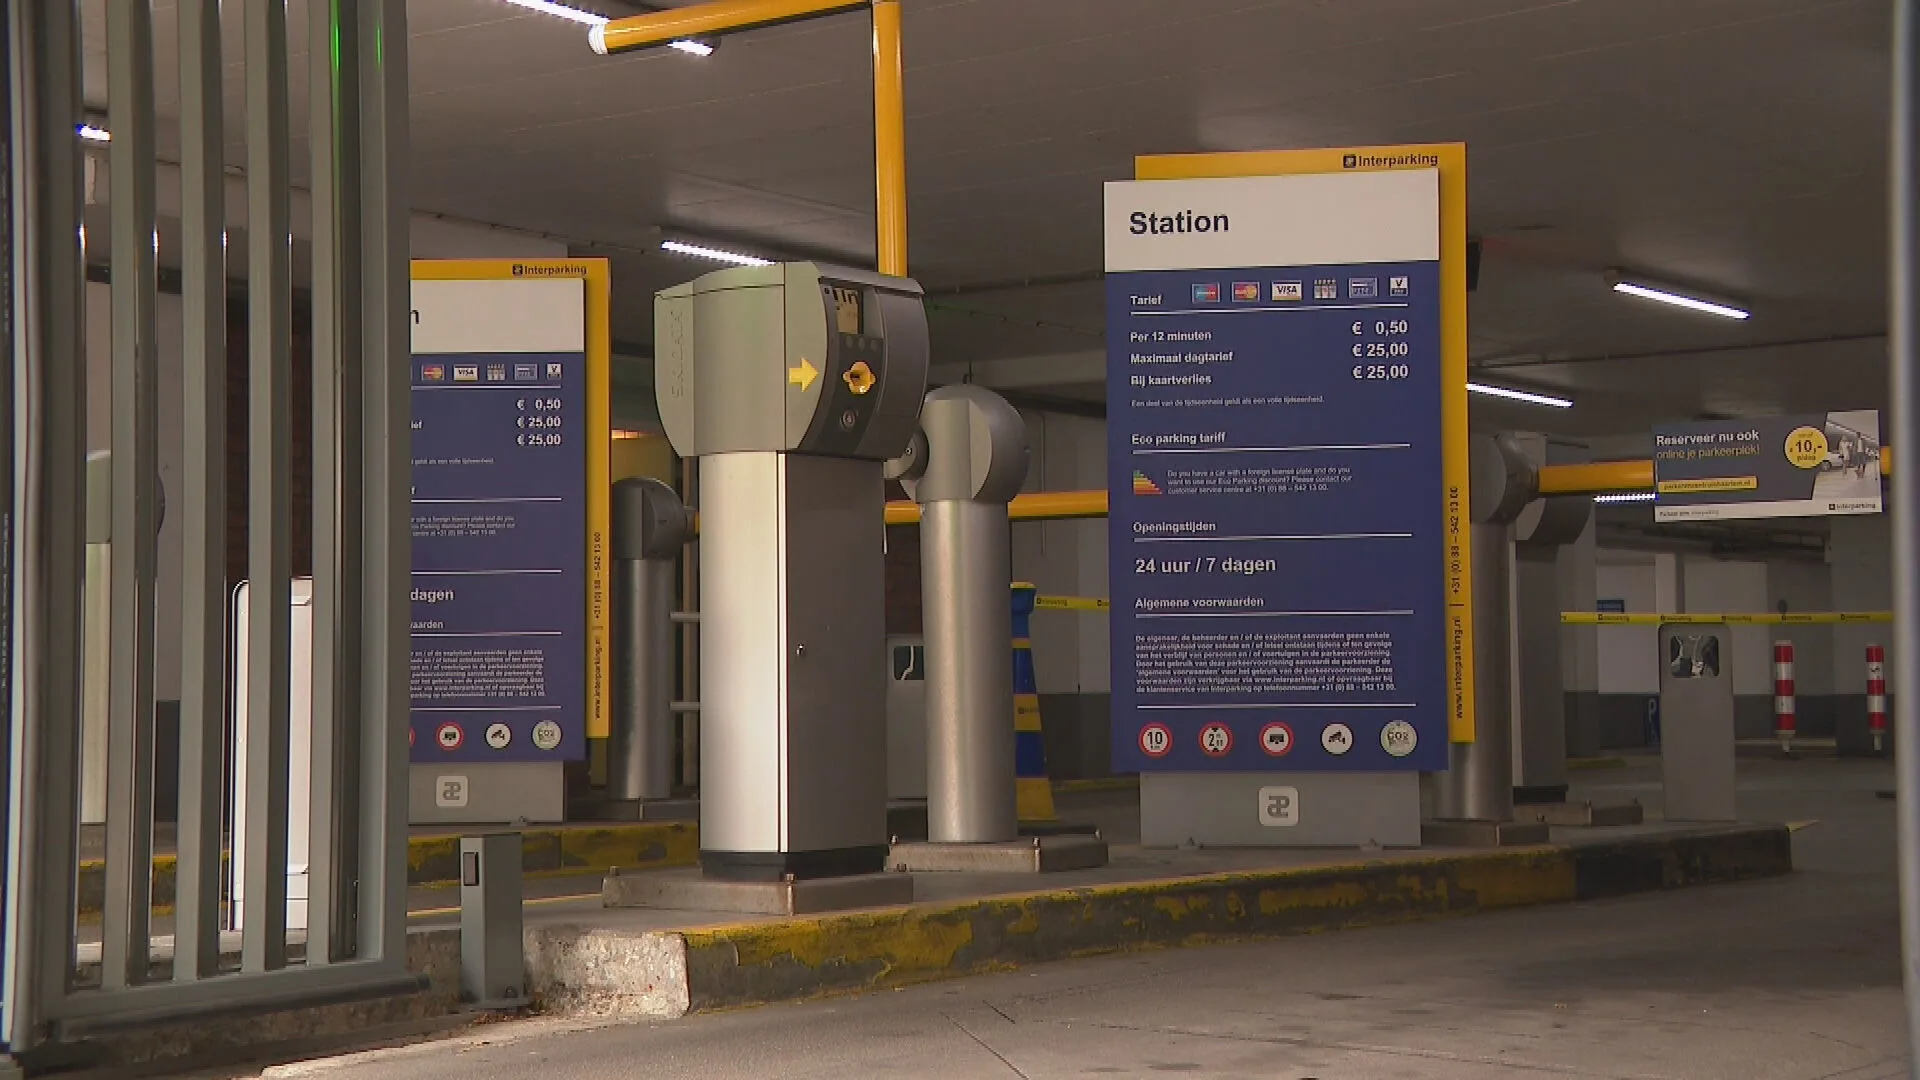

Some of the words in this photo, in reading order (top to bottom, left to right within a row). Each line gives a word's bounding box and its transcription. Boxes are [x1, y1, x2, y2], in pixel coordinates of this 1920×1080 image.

[1358, 153, 1438, 168] Interparking
[1129, 209, 1230, 235] Station
[524, 265, 587, 276] Interparking
[1276, 285, 1298, 294] VISA
[1130, 295, 1162, 305] Tarief
[1351, 321, 1362, 335] €
[1374, 320, 1408, 336] 0,50
[1130, 332, 1150, 341] Per
[1152, 331, 1165, 341] 12
[1167, 330, 1212, 340] minuten
[1352, 343, 1362, 357] €
[1366, 342, 1409, 358] 25,00
[1130, 352, 1182, 363] Maximaal
[1184, 352, 1234, 364] dagtarief
[1352, 365, 1363, 379] €
[1367, 364, 1409, 380] 25,00
[1130, 375, 1145, 388] Bij
[1148, 374, 1212, 385] kaartverlies
[516, 399, 525, 411] €
[535, 398, 561, 412] 0,50
[516, 416, 525, 429] €
[528, 416, 562, 430] 25,00
[516, 434, 525, 446] €
[528, 434, 562, 447] 25,00
[1132, 433, 1152, 445] Eco
[1155, 433, 1197, 446] parking
[1199, 431, 1227, 443] tariff
[1656, 433, 1716, 447] Reserveer
[1718, 432, 1735, 443] nu
[1737, 429, 1760, 442] ook
[1656, 447, 1686, 460] online
[1132, 521, 1217, 534] Openingstijden
[1135, 558, 1156, 573] 24
[1161, 560, 1191, 573] uur
[1194, 558, 1201, 573] /
[1205, 557, 1216, 572] 7
[1221, 556, 1277, 575] dagen
[410, 587, 455, 604] dagen
[1134, 597, 1190, 610] Algemene
[1192, 595, 1265, 608] voorwaarden
[1147, 731, 1163, 745] 10
